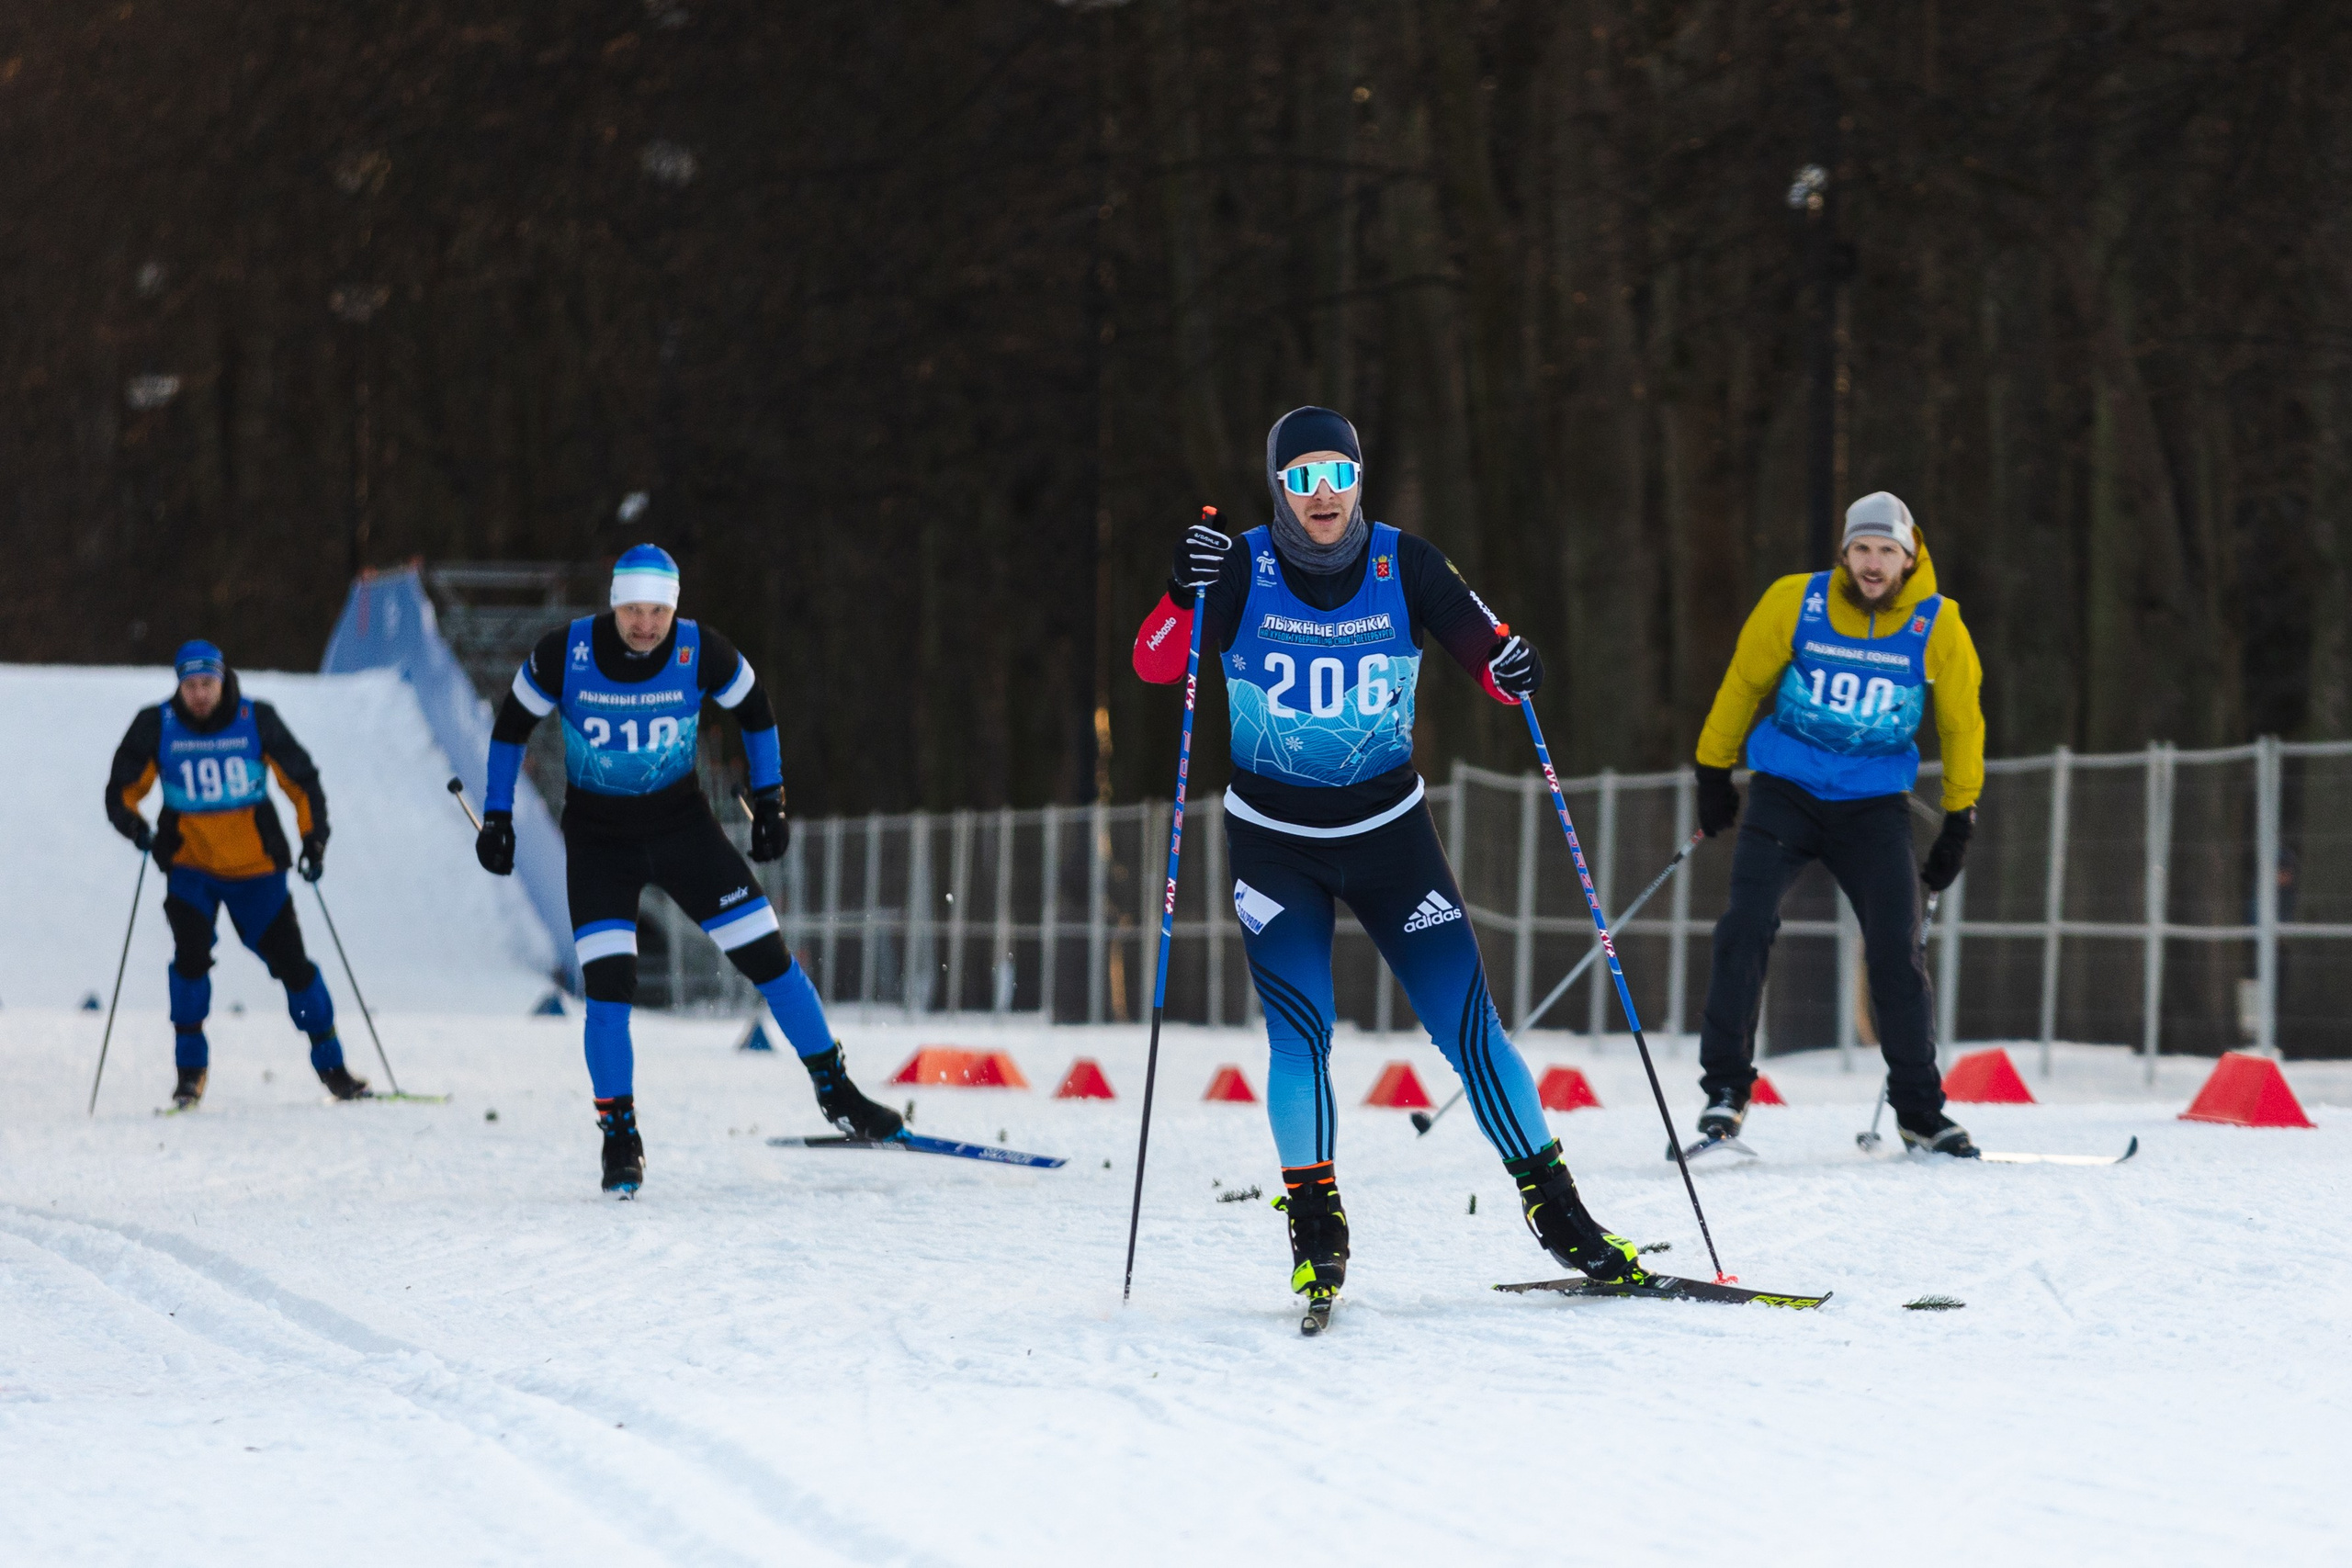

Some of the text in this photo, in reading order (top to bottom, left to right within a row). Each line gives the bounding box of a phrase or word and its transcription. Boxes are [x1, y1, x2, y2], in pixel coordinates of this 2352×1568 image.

[1146, 616, 1177, 651] Webasto
[1263, 615, 1390, 637] ЛЫЖНЫЕ ГОНКИ
[579, 690, 684, 705] ЛЫЖНЫЕ ГОНКИ
[1264, 652, 1388, 718] 206
[1810, 668, 1894, 717] 190
[583, 716, 679, 753] 210
[179, 756, 249, 802] 199
[719, 886, 749, 908] Swix
[1404, 907, 1462, 933] adidas
[1749, 1295, 1820, 1309] FISCHER
